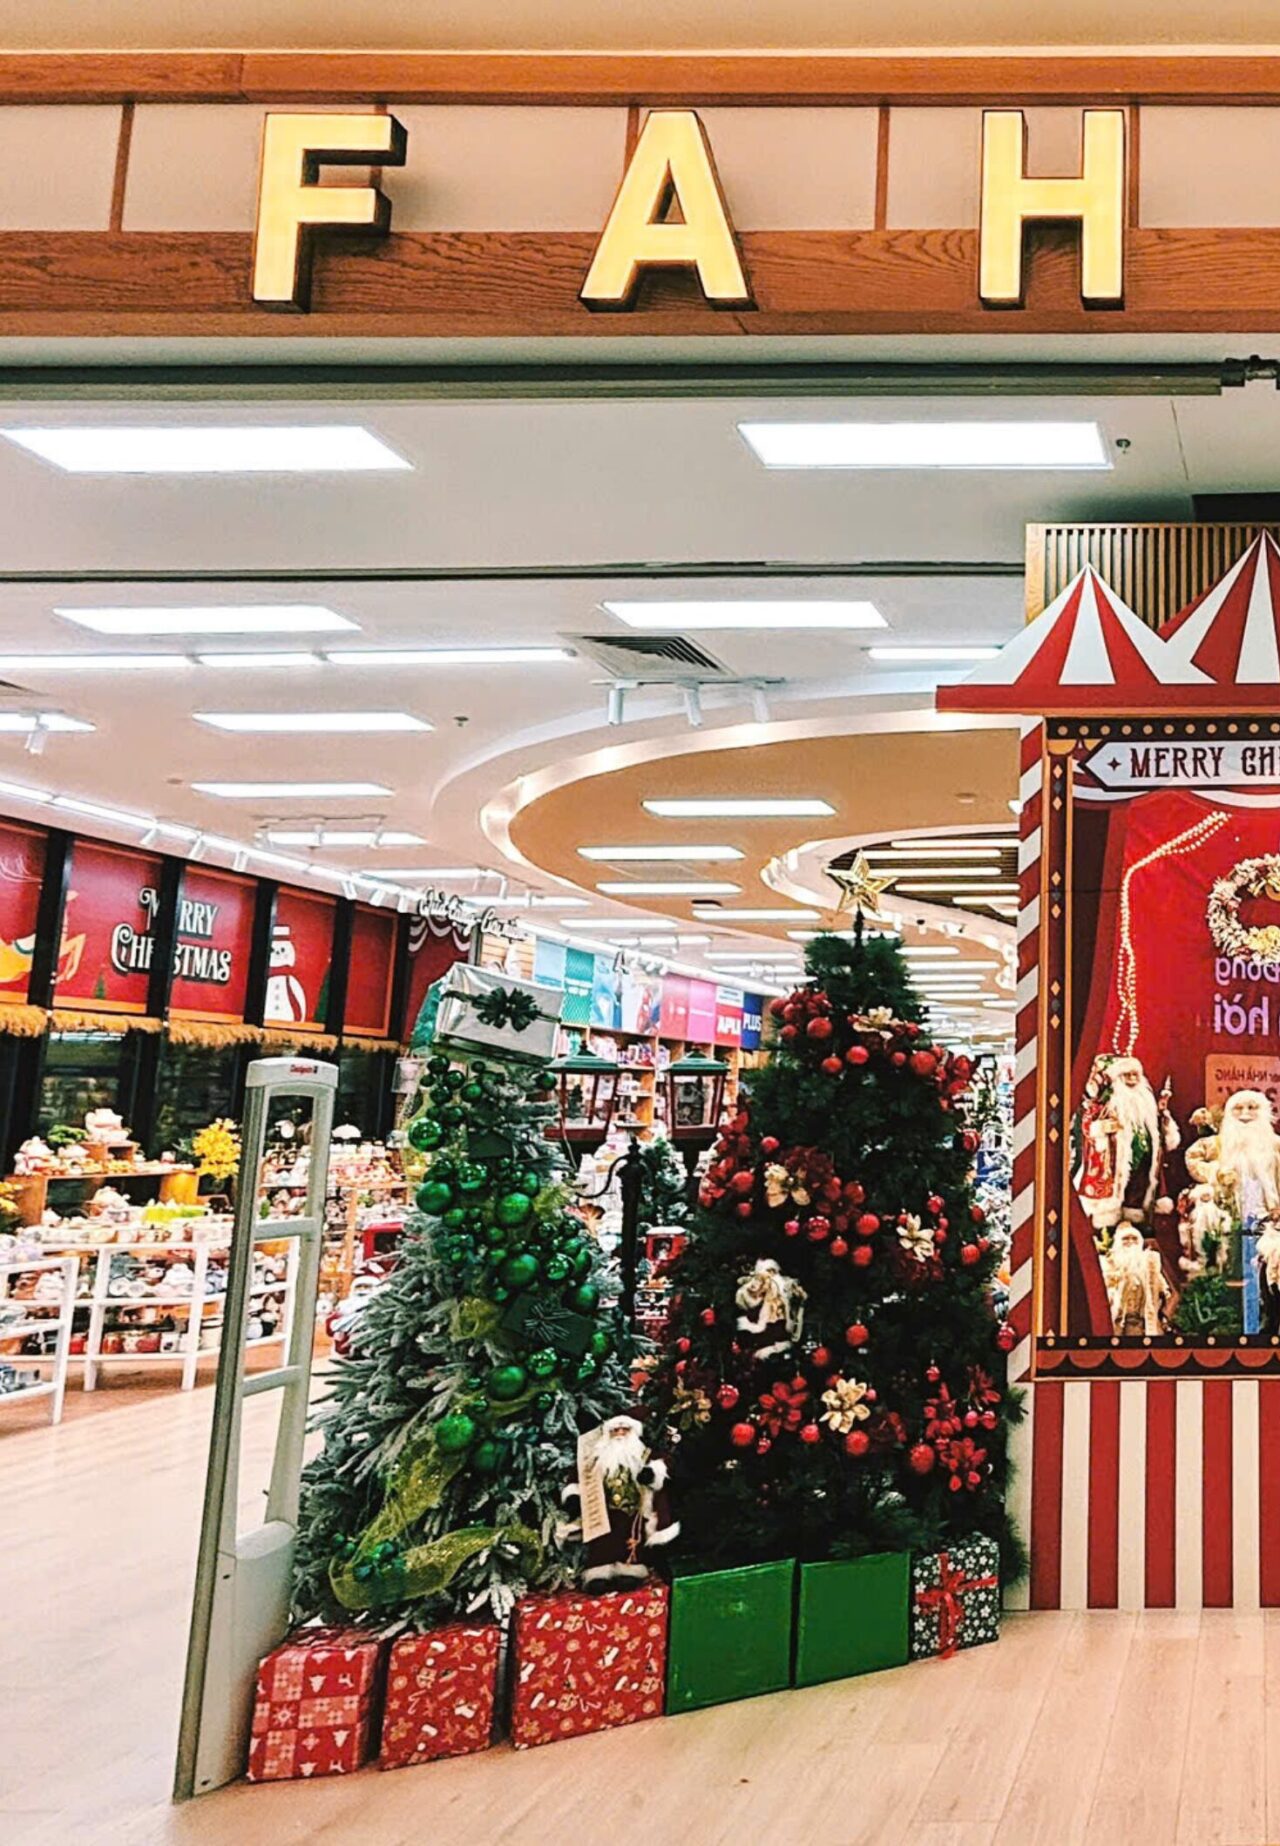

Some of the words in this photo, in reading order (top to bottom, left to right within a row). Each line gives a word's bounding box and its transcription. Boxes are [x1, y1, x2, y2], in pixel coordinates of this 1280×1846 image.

[1130, 747, 1224, 778] MERRY
[140, 887, 218, 936] MRRY
[743, 1012, 762, 1031] PLUS
